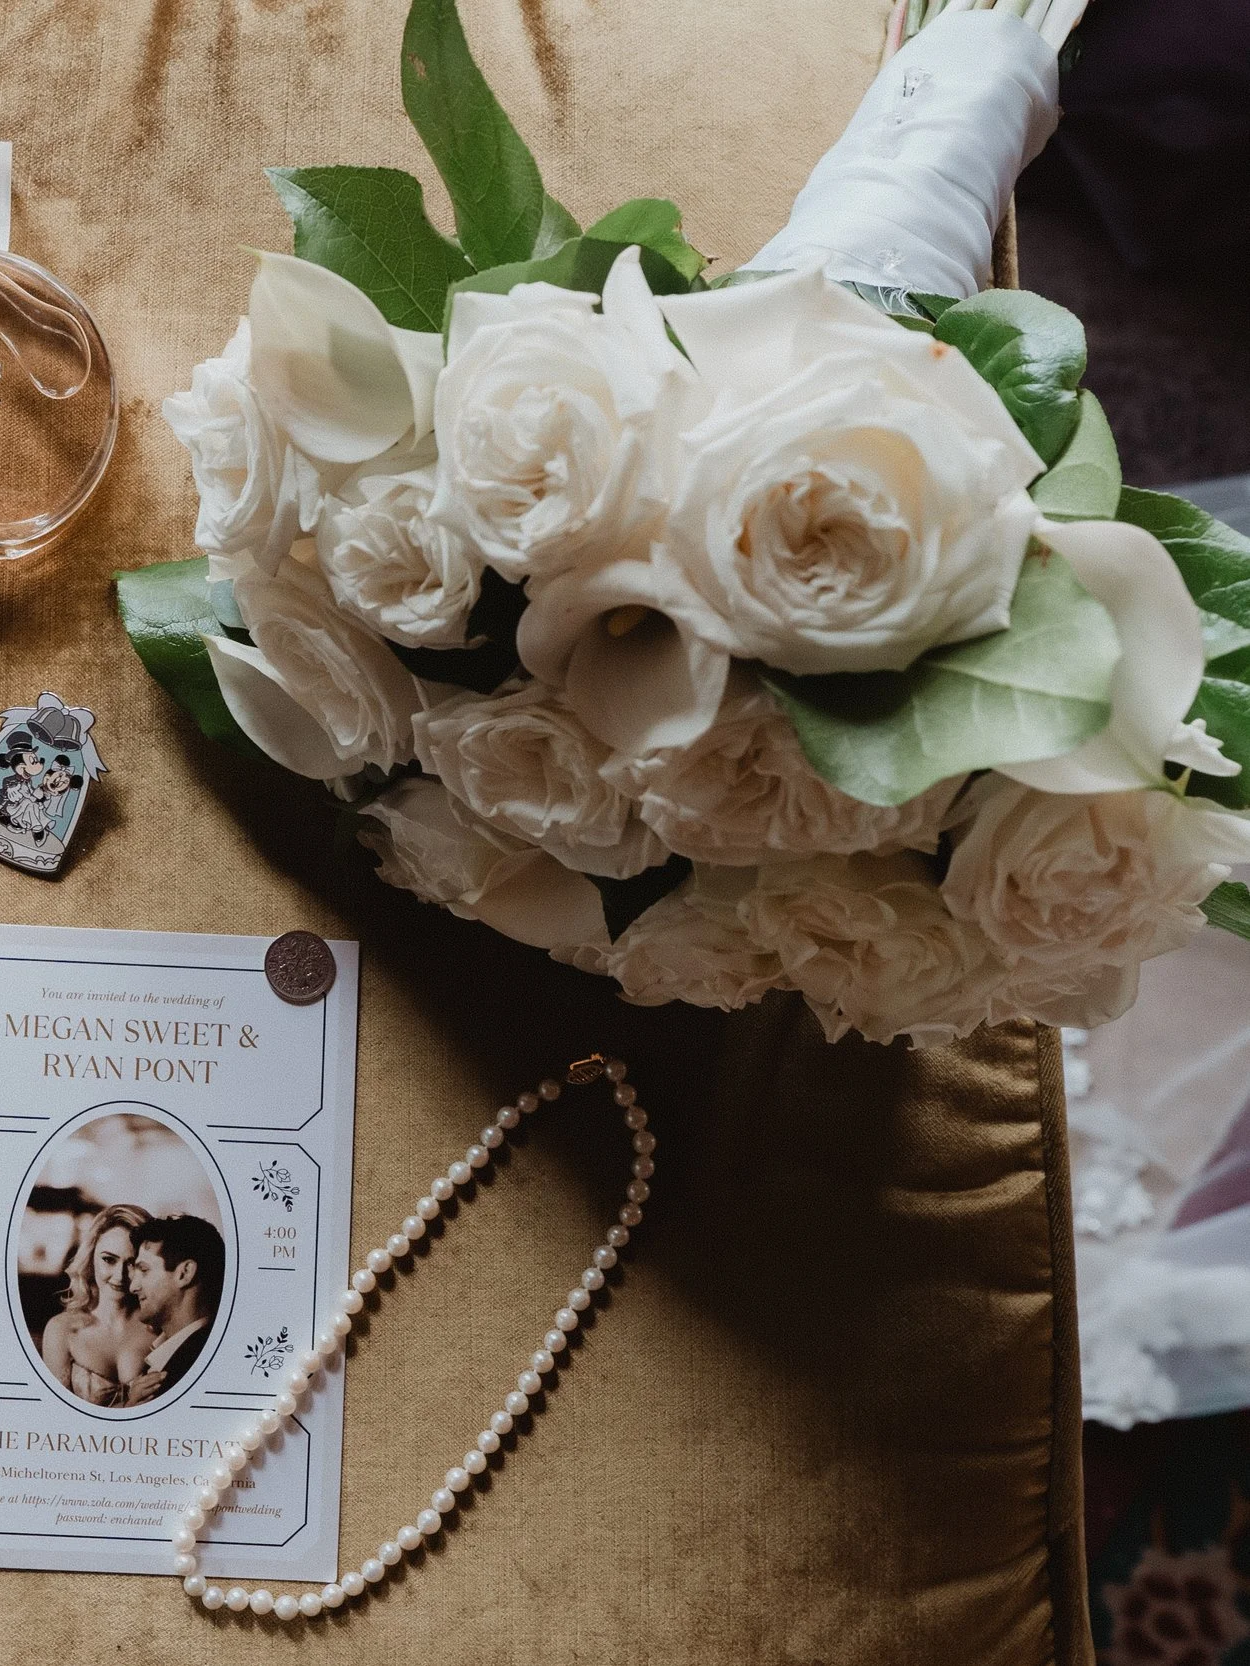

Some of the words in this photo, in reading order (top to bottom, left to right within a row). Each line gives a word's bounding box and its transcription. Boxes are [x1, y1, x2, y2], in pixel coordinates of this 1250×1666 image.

[42, 987, 62, 1000] You
[66, 991, 84, 1001] are
[87, 990, 127, 1002] invited
[129, 993, 140, 1003] to
[143, 992, 160, 1004] the
[163, 994, 211, 1010] wedding
[212, 995, 226, 1010] of
[5, 1013, 114, 1042] MEGAN
[124, 1018, 232, 1047] SWEET
[238, 1024, 260, 1049] &
[43, 1053, 124, 1080] RYAN
[134, 1056, 219, 1084] PONT
[263, 1226, 297, 1240] 4:00
[272, 1244, 296, 1259] PM
[26, 1431, 160, 1457] PARAMOUR
[166, 1438, 255, 1461] ESTA
[1, 1466, 86, 1482] Micheltorena
[110, 1471, 132, 1484] Los
[192, 1474, 256, 1490] Carnia
[7, 1494, 20, 1504] at
[55, 1512, 108, 1525] password:
[110, 1515, 164, 1527] enchanted
